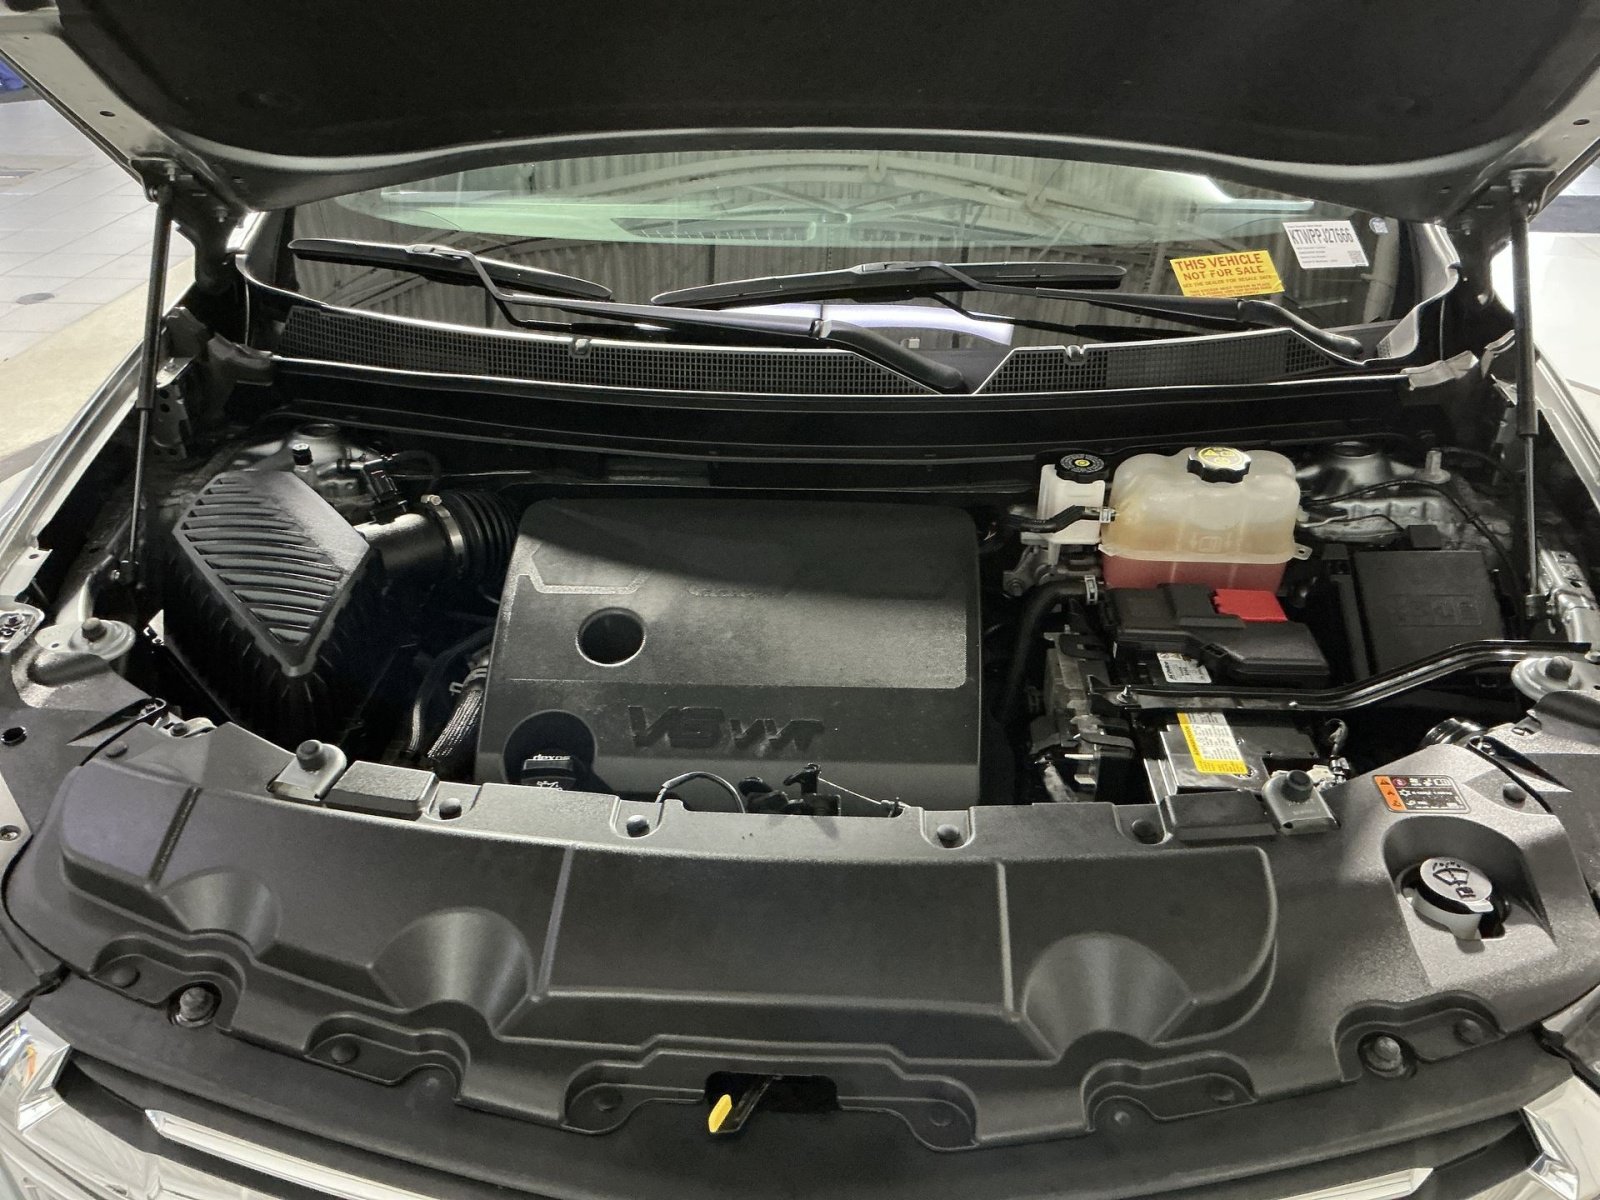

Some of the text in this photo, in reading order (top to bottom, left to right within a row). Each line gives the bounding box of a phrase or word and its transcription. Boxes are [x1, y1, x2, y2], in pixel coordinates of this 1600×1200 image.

[1176, 253, 1264, 271] THIS VEHICLE
[1183, 265, 1265, 281] NOT FOR SALE
[628, 705, 726, 749] V6
